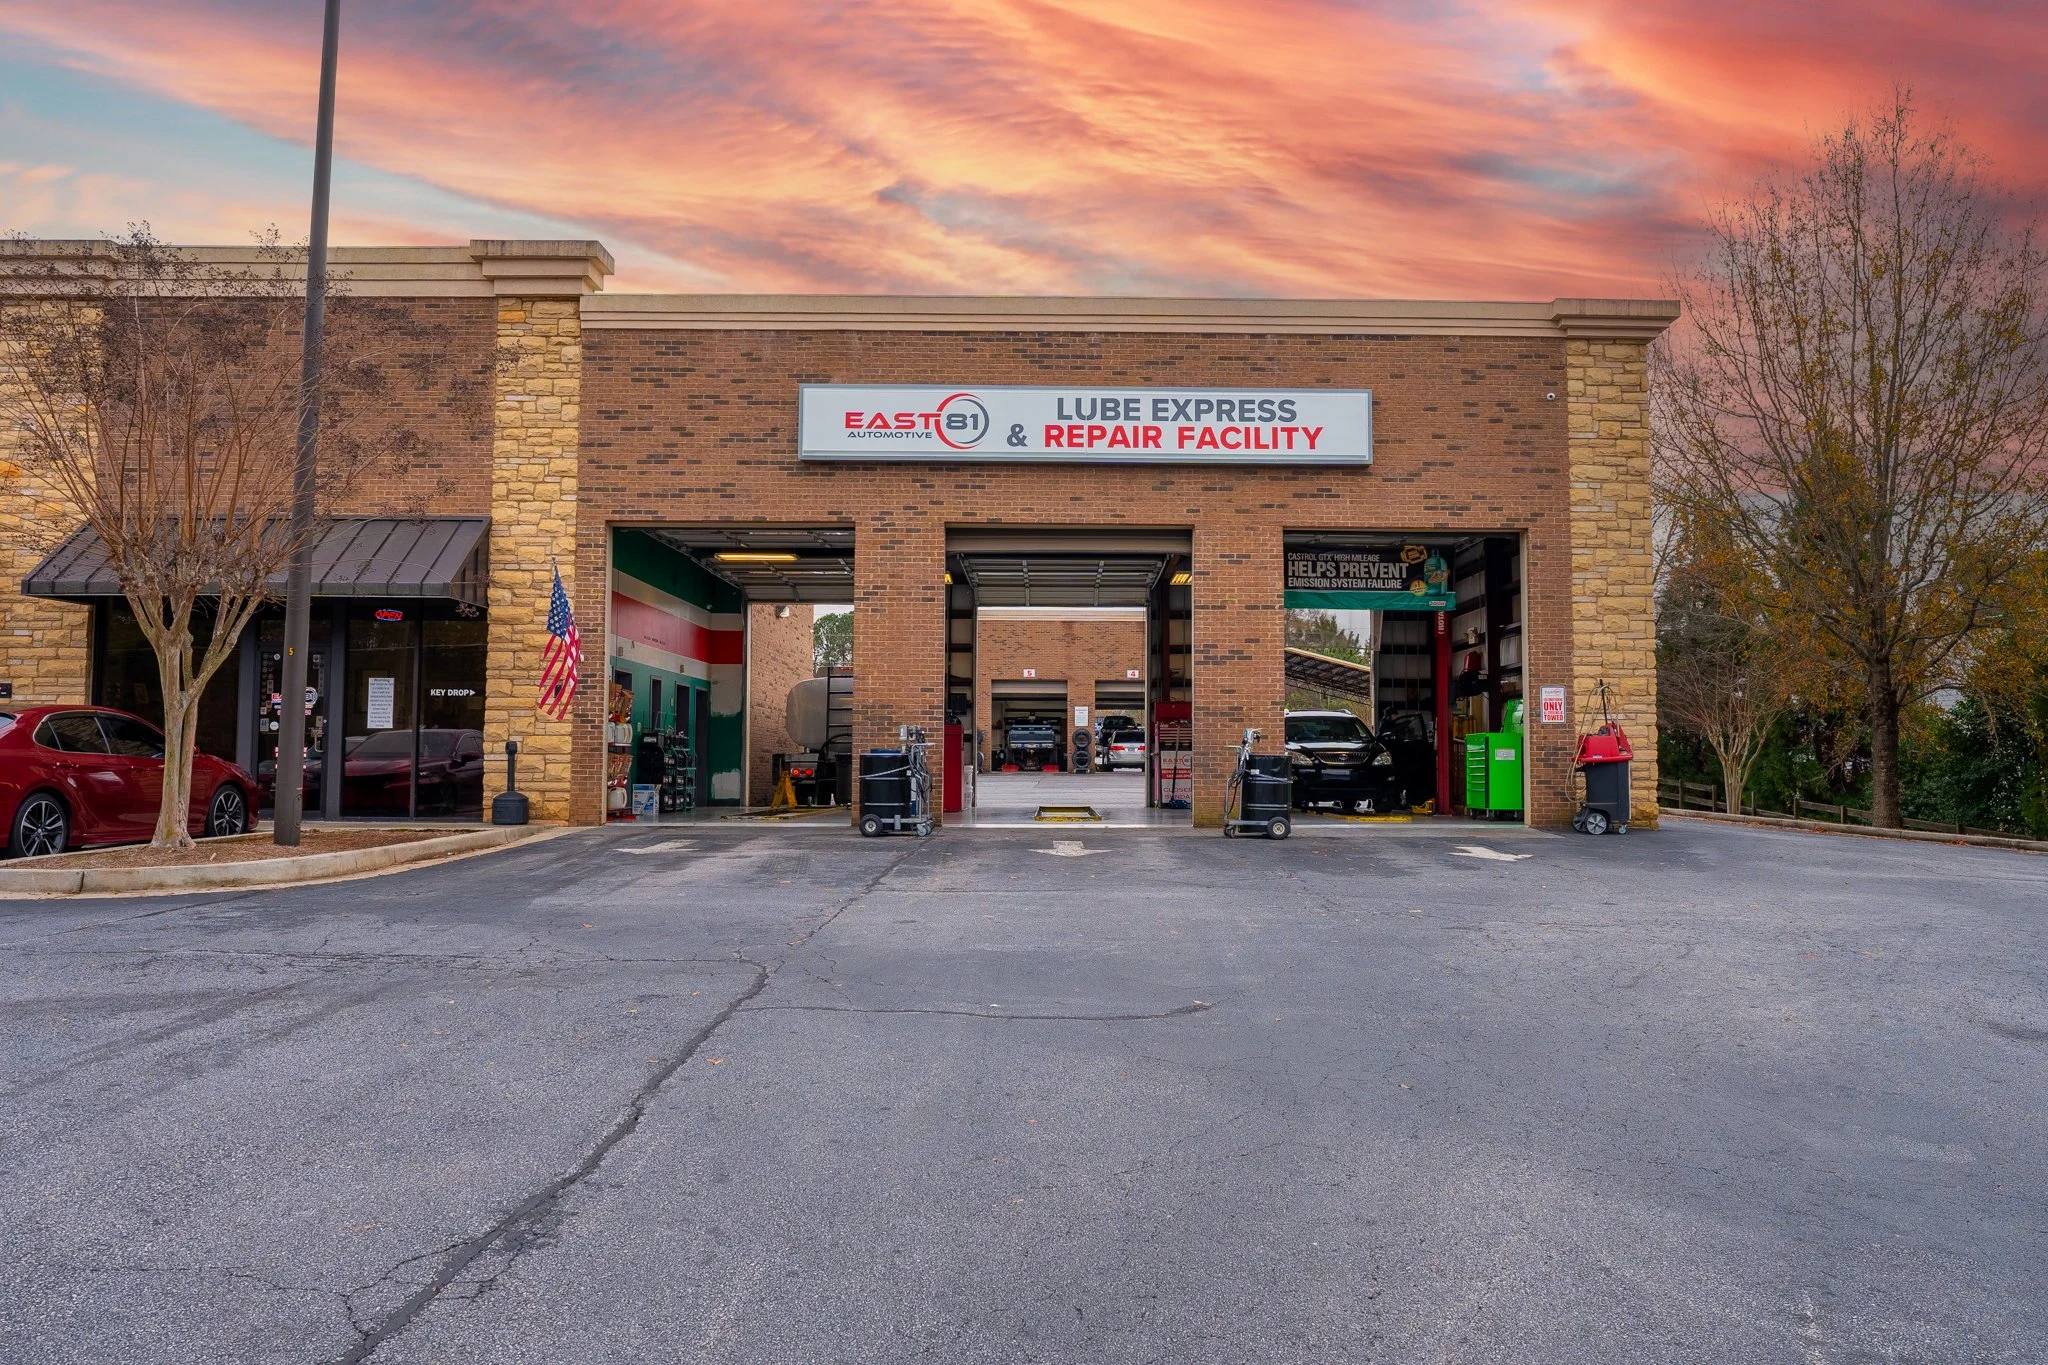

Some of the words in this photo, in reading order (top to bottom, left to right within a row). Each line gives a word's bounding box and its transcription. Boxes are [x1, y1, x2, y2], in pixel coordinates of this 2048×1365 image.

[1057, 397, 1141, 421] LUBE
[1151, 398, 1297, 423] EXPRESS
[844, 411, 941, 430] EAST
[945, 413, 979, 430] 81
[847, 431, 933, 439] AUTOMOTIVE
[1006, 423, 1028, 447] &
[1044, 424, 1163, 449] REPAIR
[1177, 426, 1324, 450] FACILITY
[1334, 553, 1351, 562] HIGH
[1352, 554, 1380, 562] MILEAGE
[1288, 561, 1336, 577] HELPS
[1339, 562, 1409, 579] PREVENT
[1288, 577, 1330, 588] EMISSION
[1331, 578, 1366, 588] SYSTEM
[1367, 579, 1402, 588] FAILURE
[375, 611, 403, 620] OPEN
[1437, 611, 1445, 631] ROTA
[288, 647, 294, 656] 5
[430, 689, 446, 697] KEY
[447, 689, 470, 697] DROP
[1544, 702, 1562, 710] ONLY
